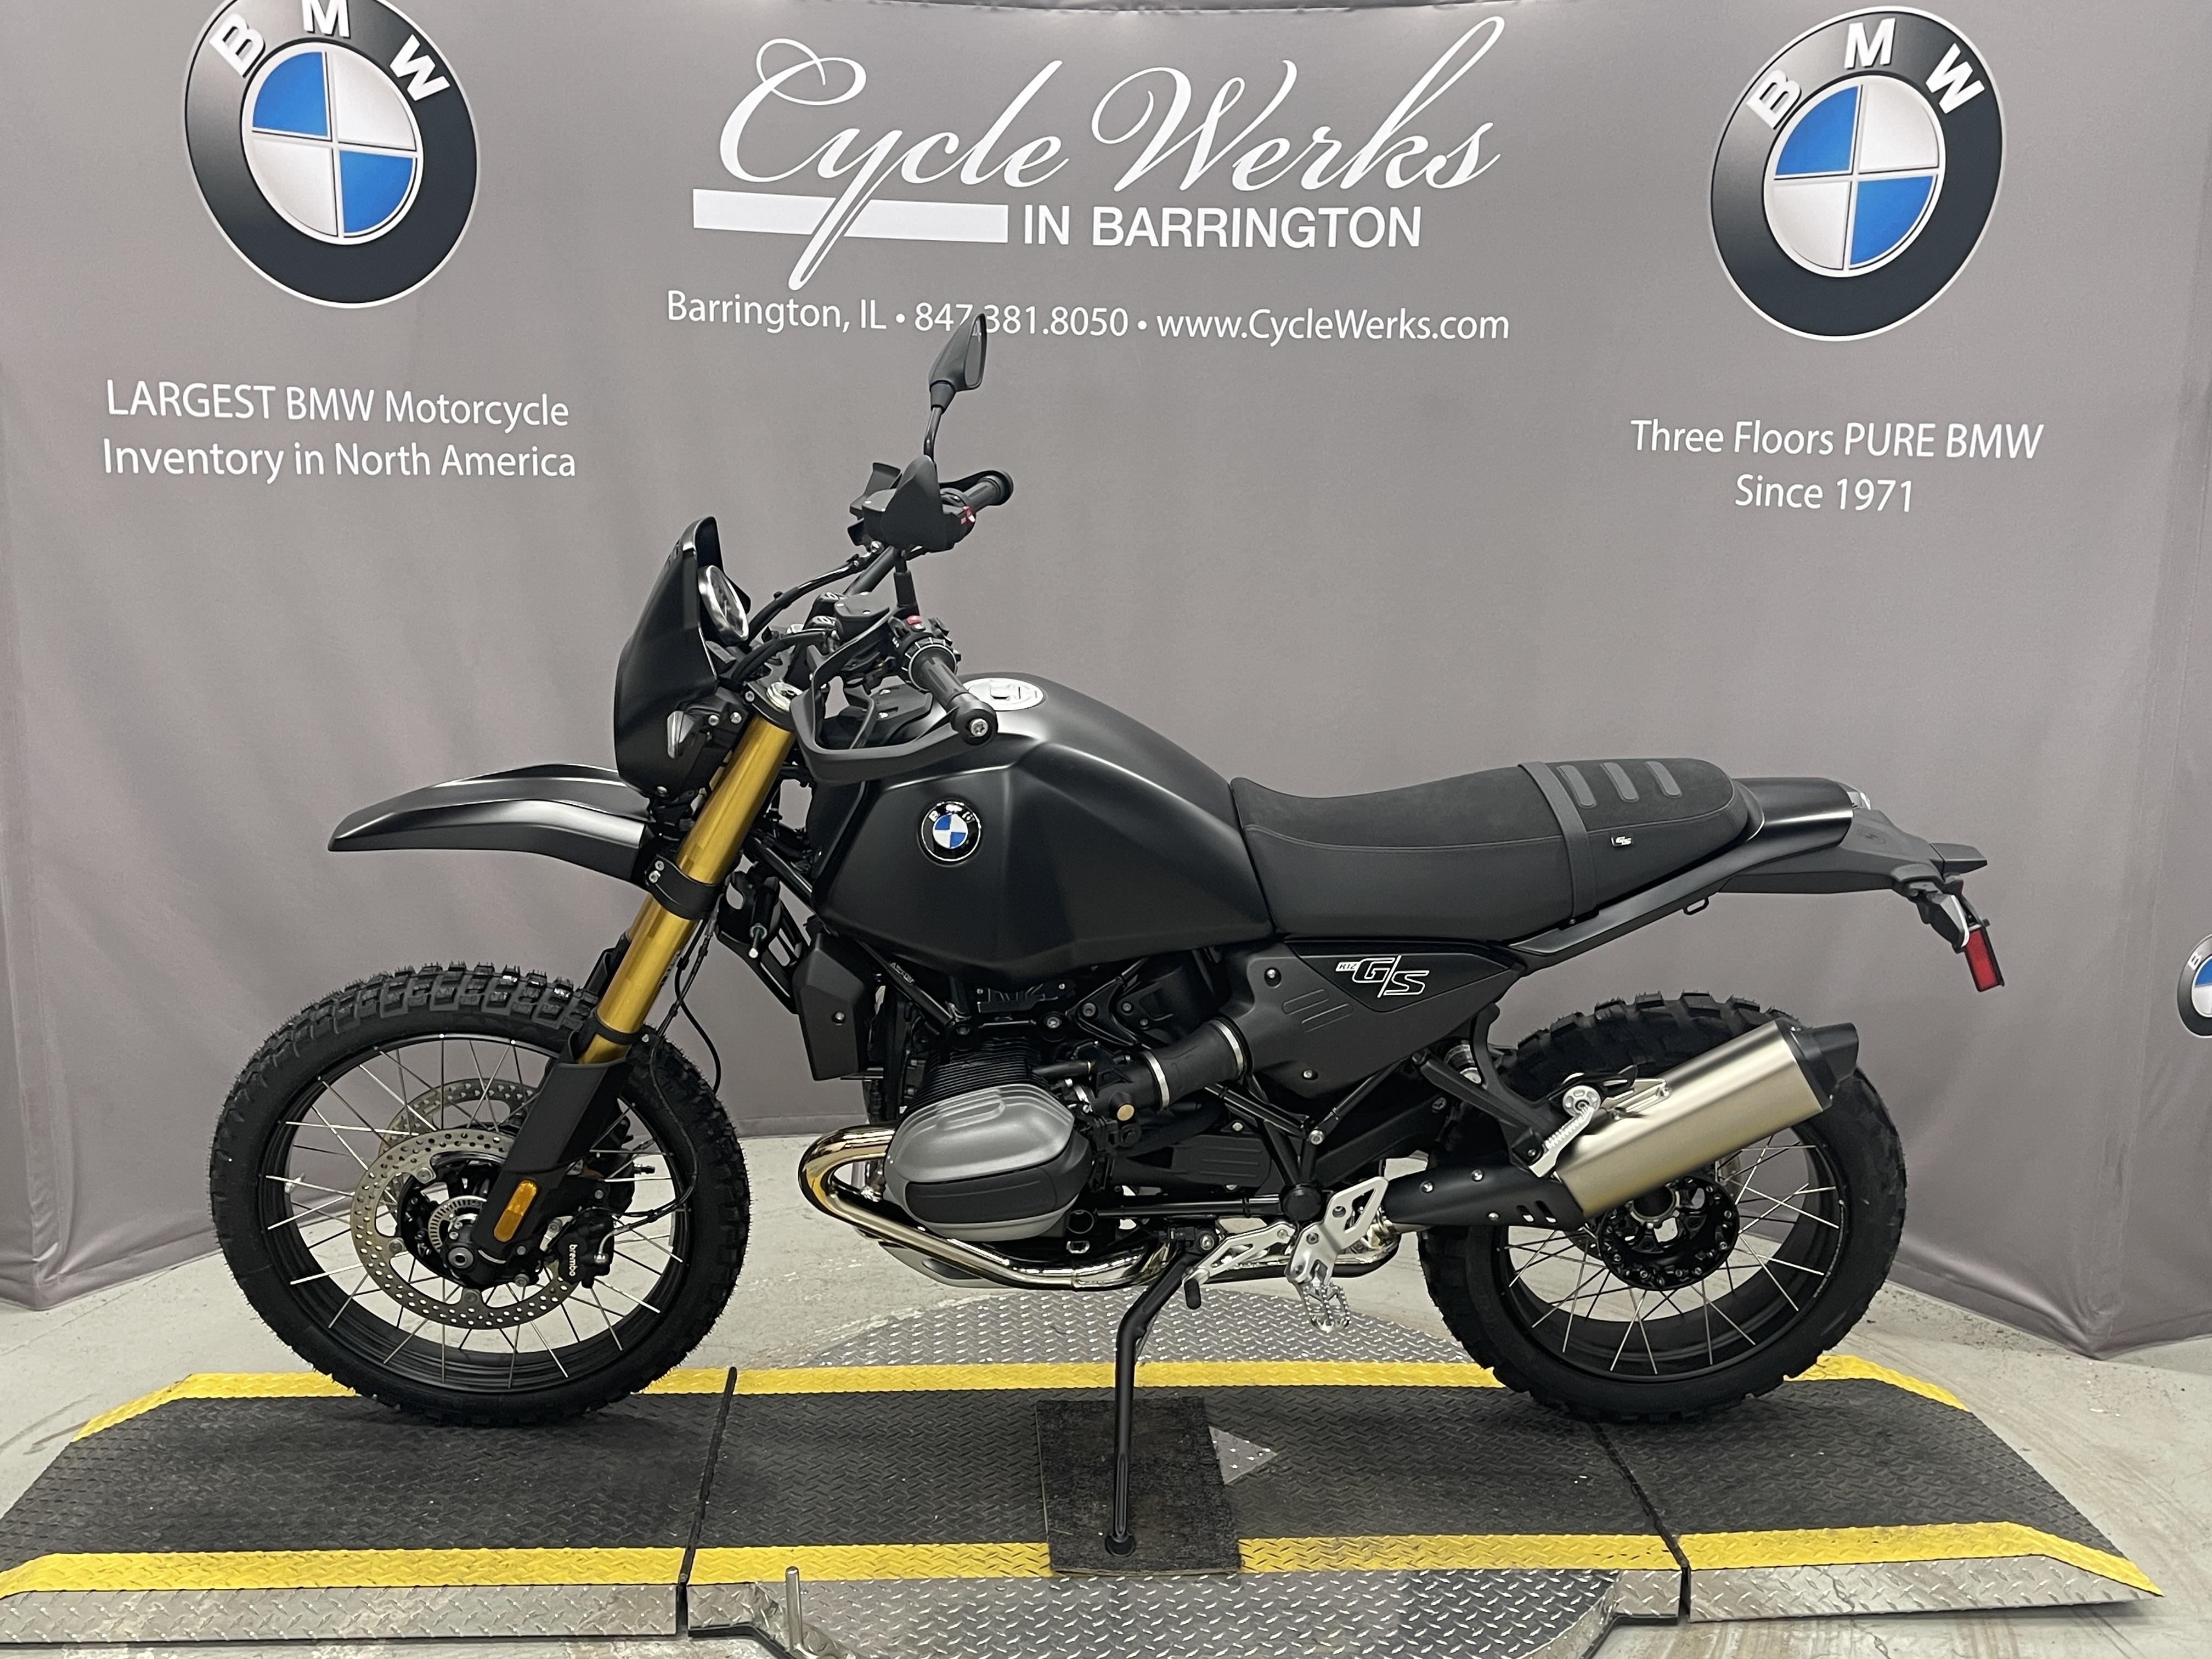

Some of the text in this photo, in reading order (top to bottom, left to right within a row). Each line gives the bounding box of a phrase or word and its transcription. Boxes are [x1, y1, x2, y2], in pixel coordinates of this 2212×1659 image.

[210, 0, 451, 101] BMW
[1746, 18, 1985, 129] BMW
[719, 15, 1505, 291] Cycle Werks
[1024, 204, 1421, 249] IN BARRINGTON
[668, 290, 850, 334] Barrington,
[860, 299, 887, 330] IL
[915, 302, 1128, 337] 847381.8050
[1156, 308, 1509, 347] www.CycleWerks.com
[106, 379, 569, 434] LARGEST BMW Motorcycle
[103, 438, 576, 484] Inventory in North America
[1630, 418, 2045, 459] Three Floors PURE BMW
[1735, 473, 1912, 512] Since 1971
[569, 1244, 578, 1277] brembo
